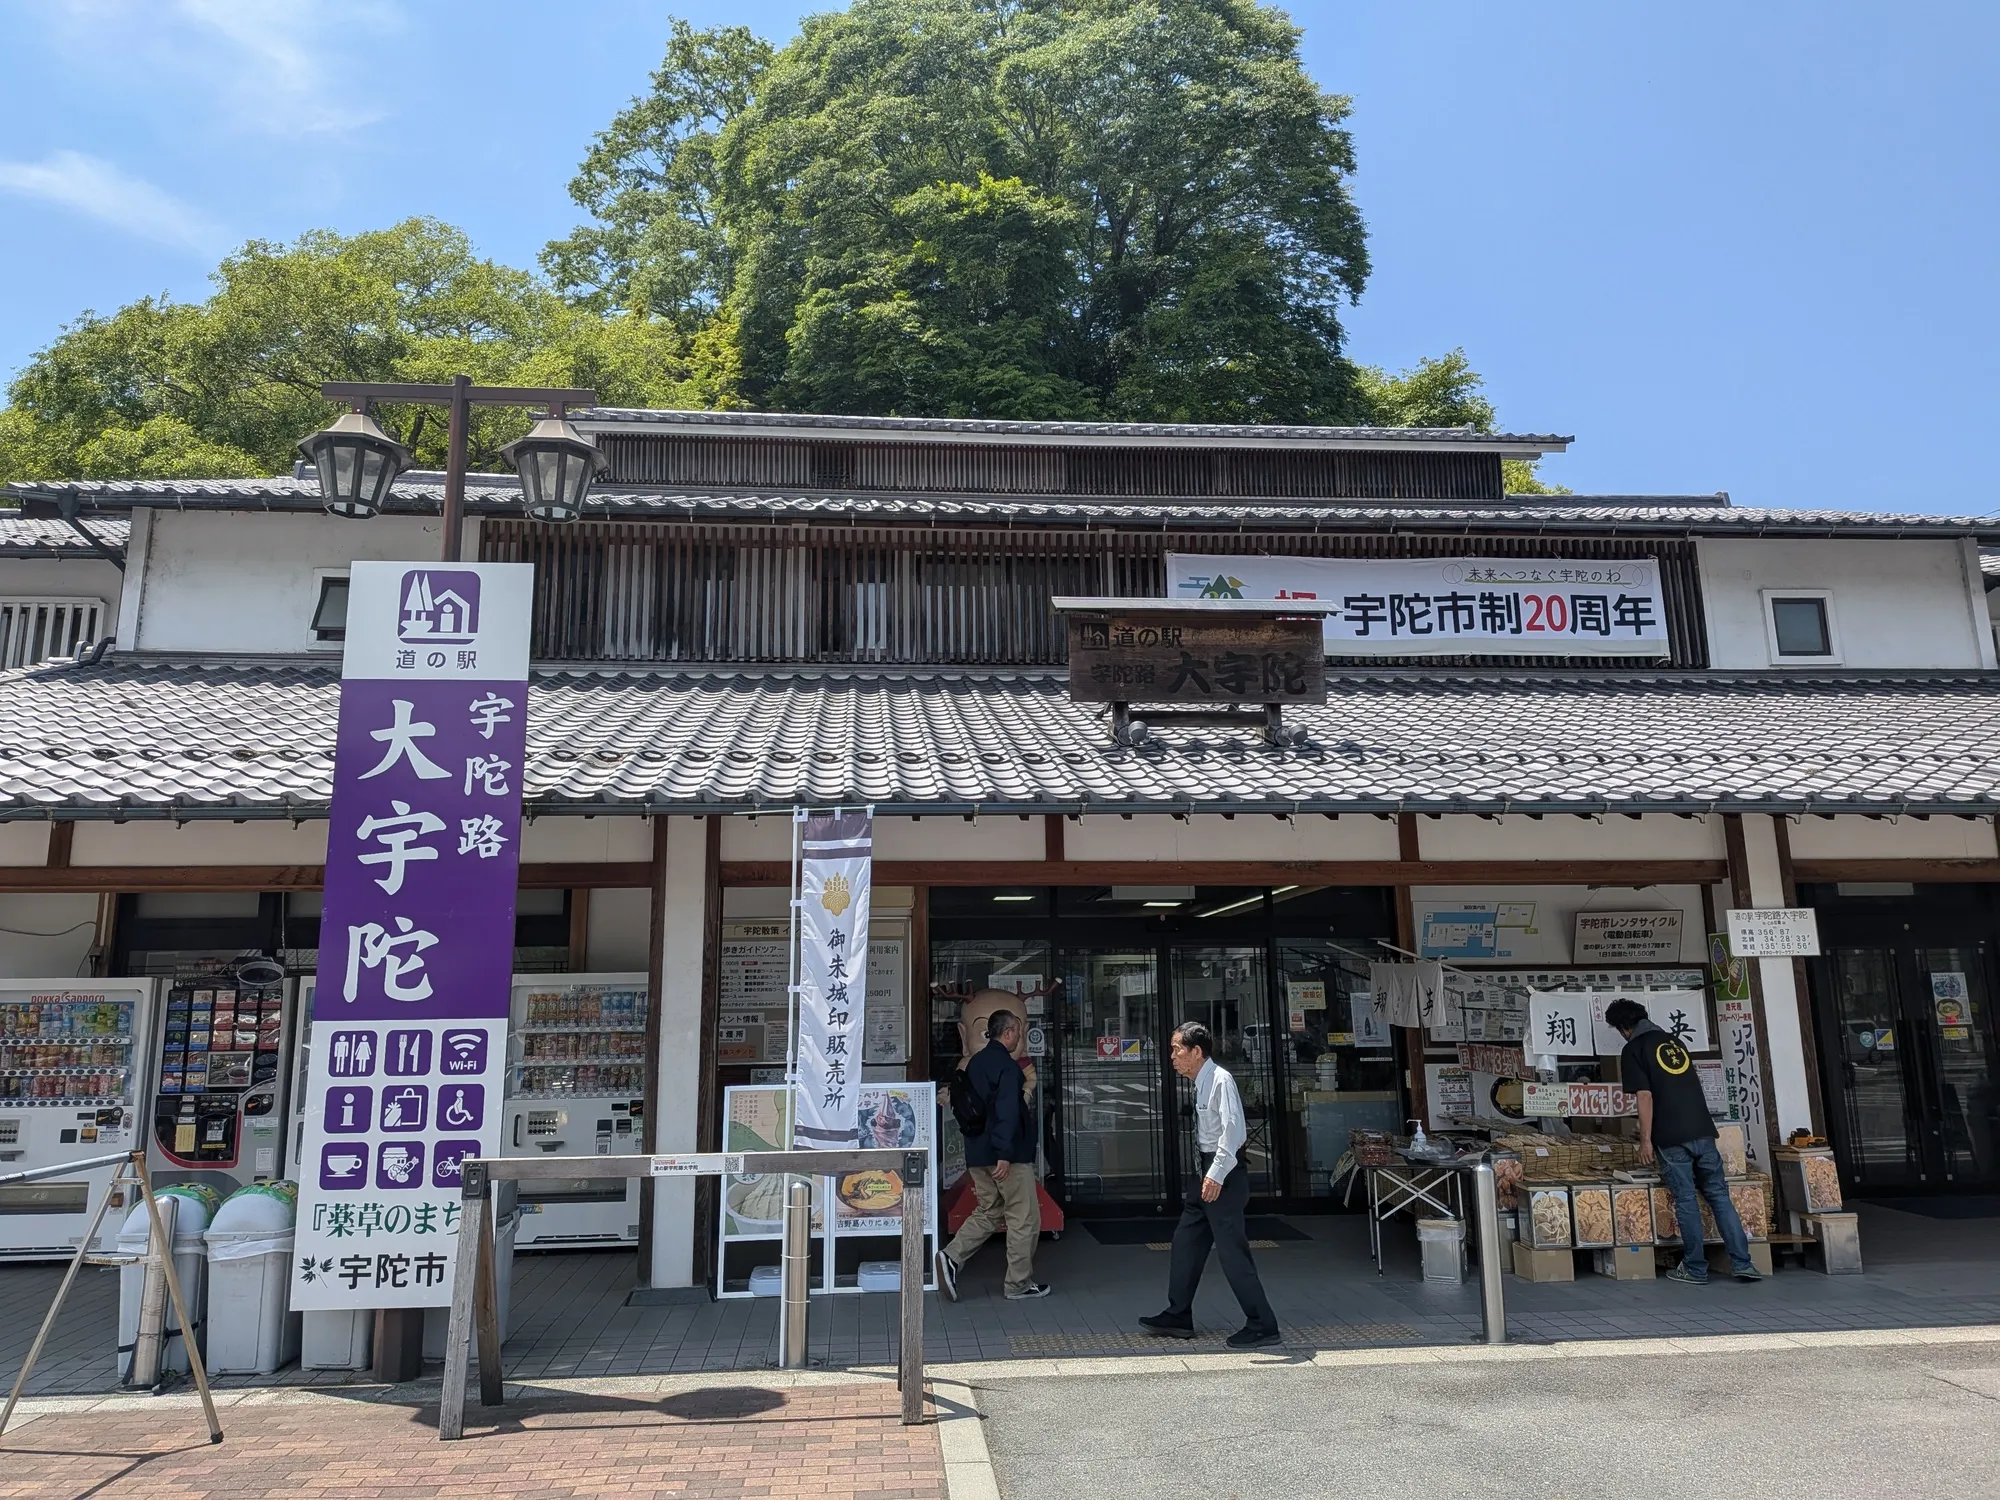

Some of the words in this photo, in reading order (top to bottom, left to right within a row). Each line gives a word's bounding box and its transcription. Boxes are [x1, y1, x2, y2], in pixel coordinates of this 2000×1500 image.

[1468, 567, 1621, 583] 未来へつなぐ宇陀のわ
[1343, 591, 1657, 637] 宇陀市制20周年
[1113, 627, 1183, 648] 道の駅
[395, 650, 477, 669] 道の駅
[1090, 663, 1156, 685] 宇陀路
[1168, 652, 1308, 695] 大宇陀
[457, 692, 514, 858] 宇陀路
[343, 700, 453, 1003] 大宇陀
[743, 926, 780, 936] 宇陀散策
[1580, 917, 1678, 929] 宇陀市レンタサイクル
[868, 945, 899, 955] 利用案内
[822, 929, 851, 1111] 御朱城印販売所
[1545, 1011, 1577, 1046] 翔
[1669, 1009, 1697, 1043] 英
[449, 1060, 477, 1071] Wi-Fi
[1570, 1088, 1609, 1115] どれでも
[1732, 1029, 1757, 1161] ソフトクリーム
[312, 1201, 461, 1238] 『薬草のまち
[338, 1251, 448, 1289] 宇陀市
